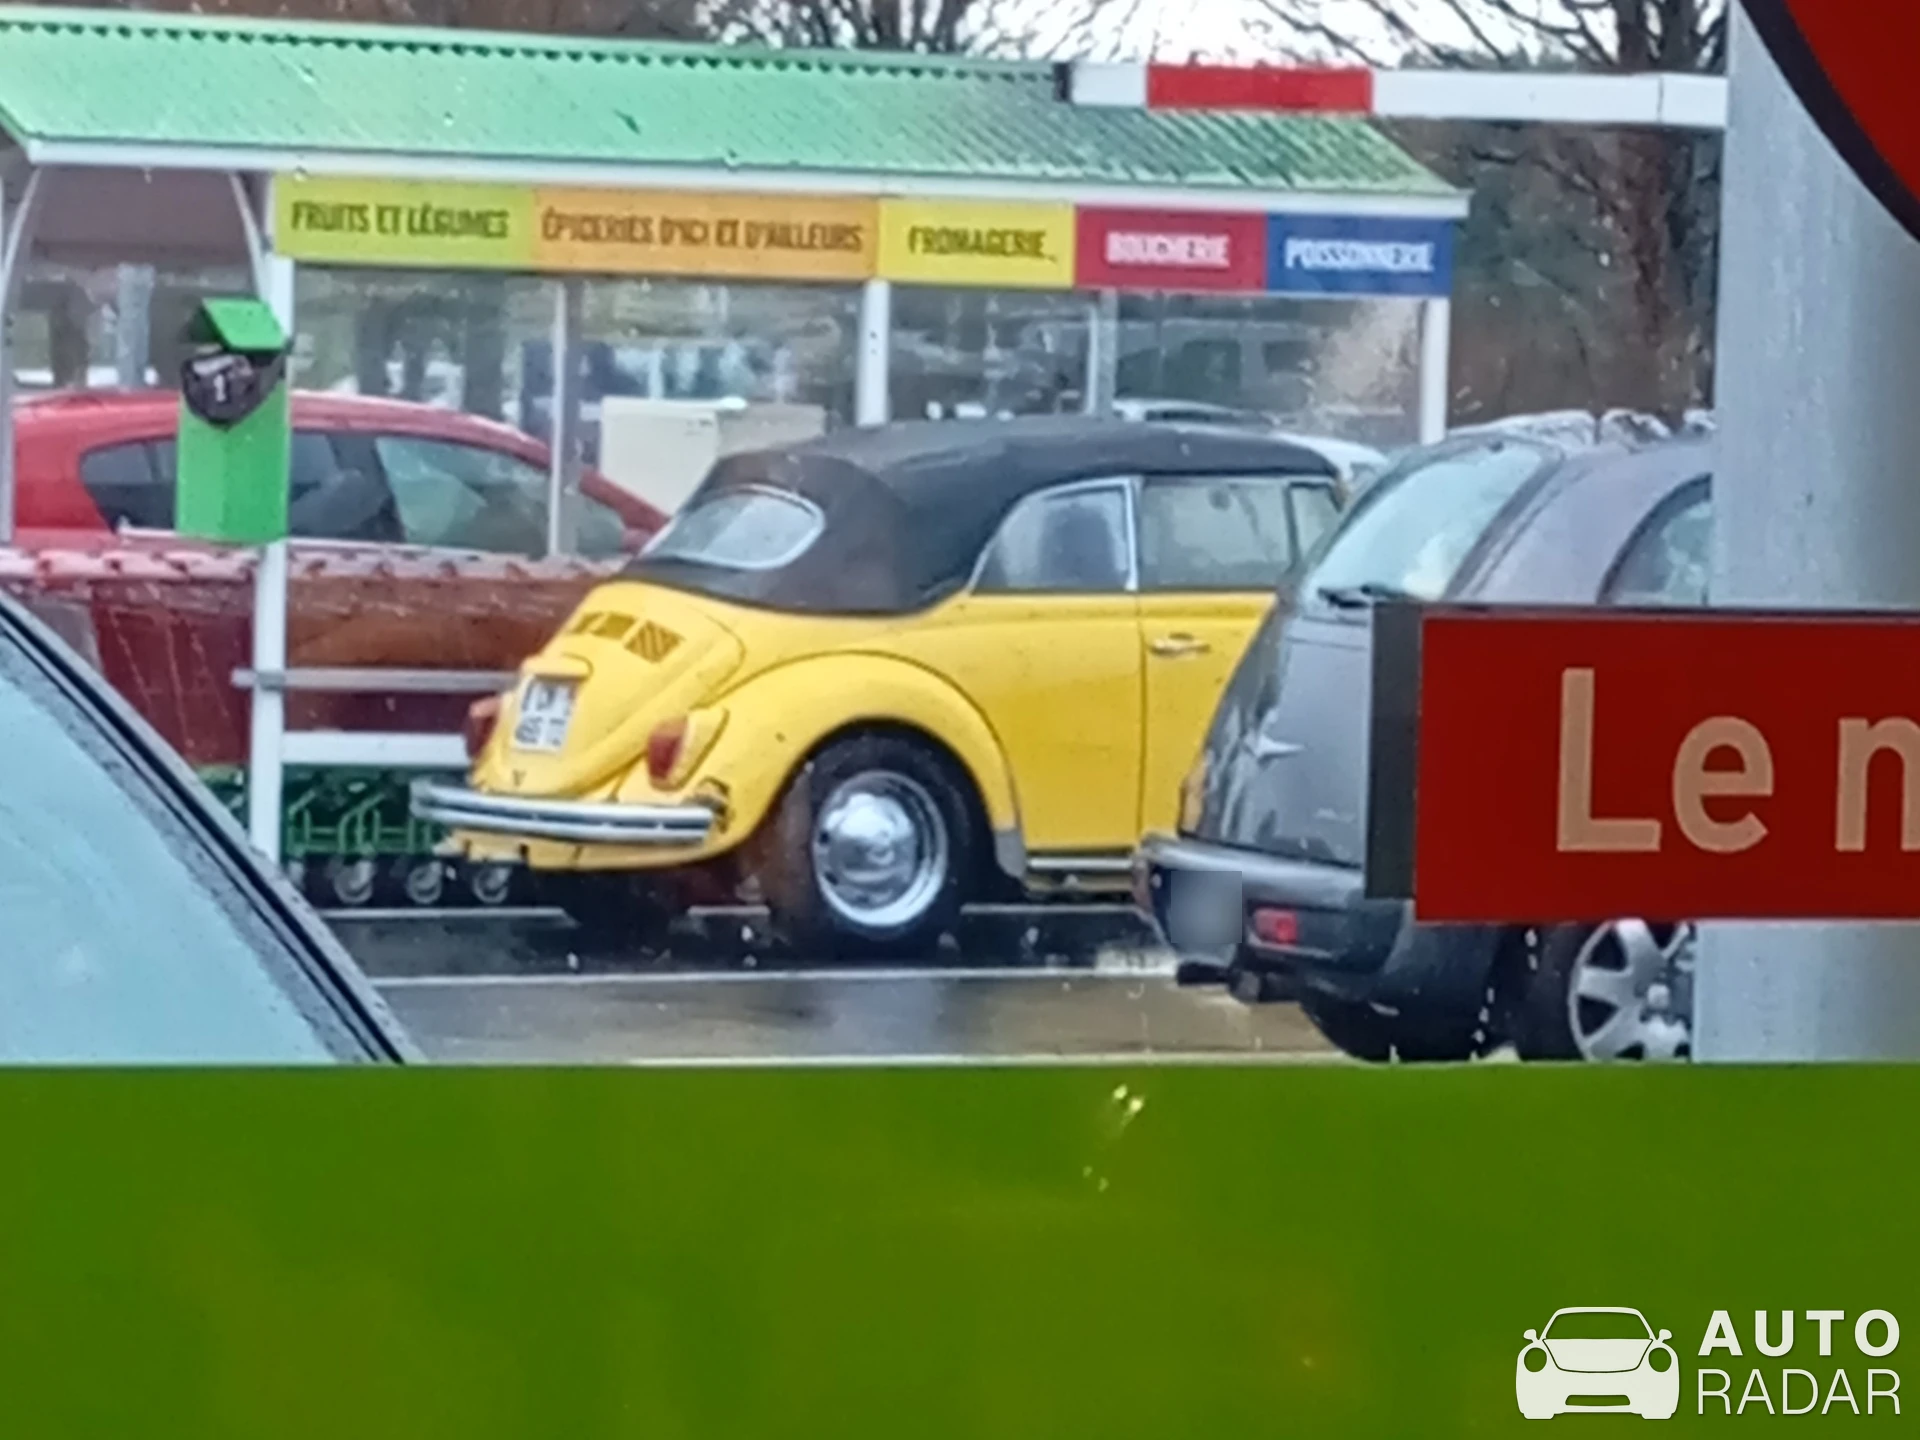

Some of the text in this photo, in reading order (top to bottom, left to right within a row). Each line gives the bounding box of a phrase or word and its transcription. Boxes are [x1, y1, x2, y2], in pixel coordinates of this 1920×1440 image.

[291, 200, 509, 240] FRUITS ET LÉGUMES
[716, 219, 739, 248] ET
[1557, 666, 1775, 854] Le
